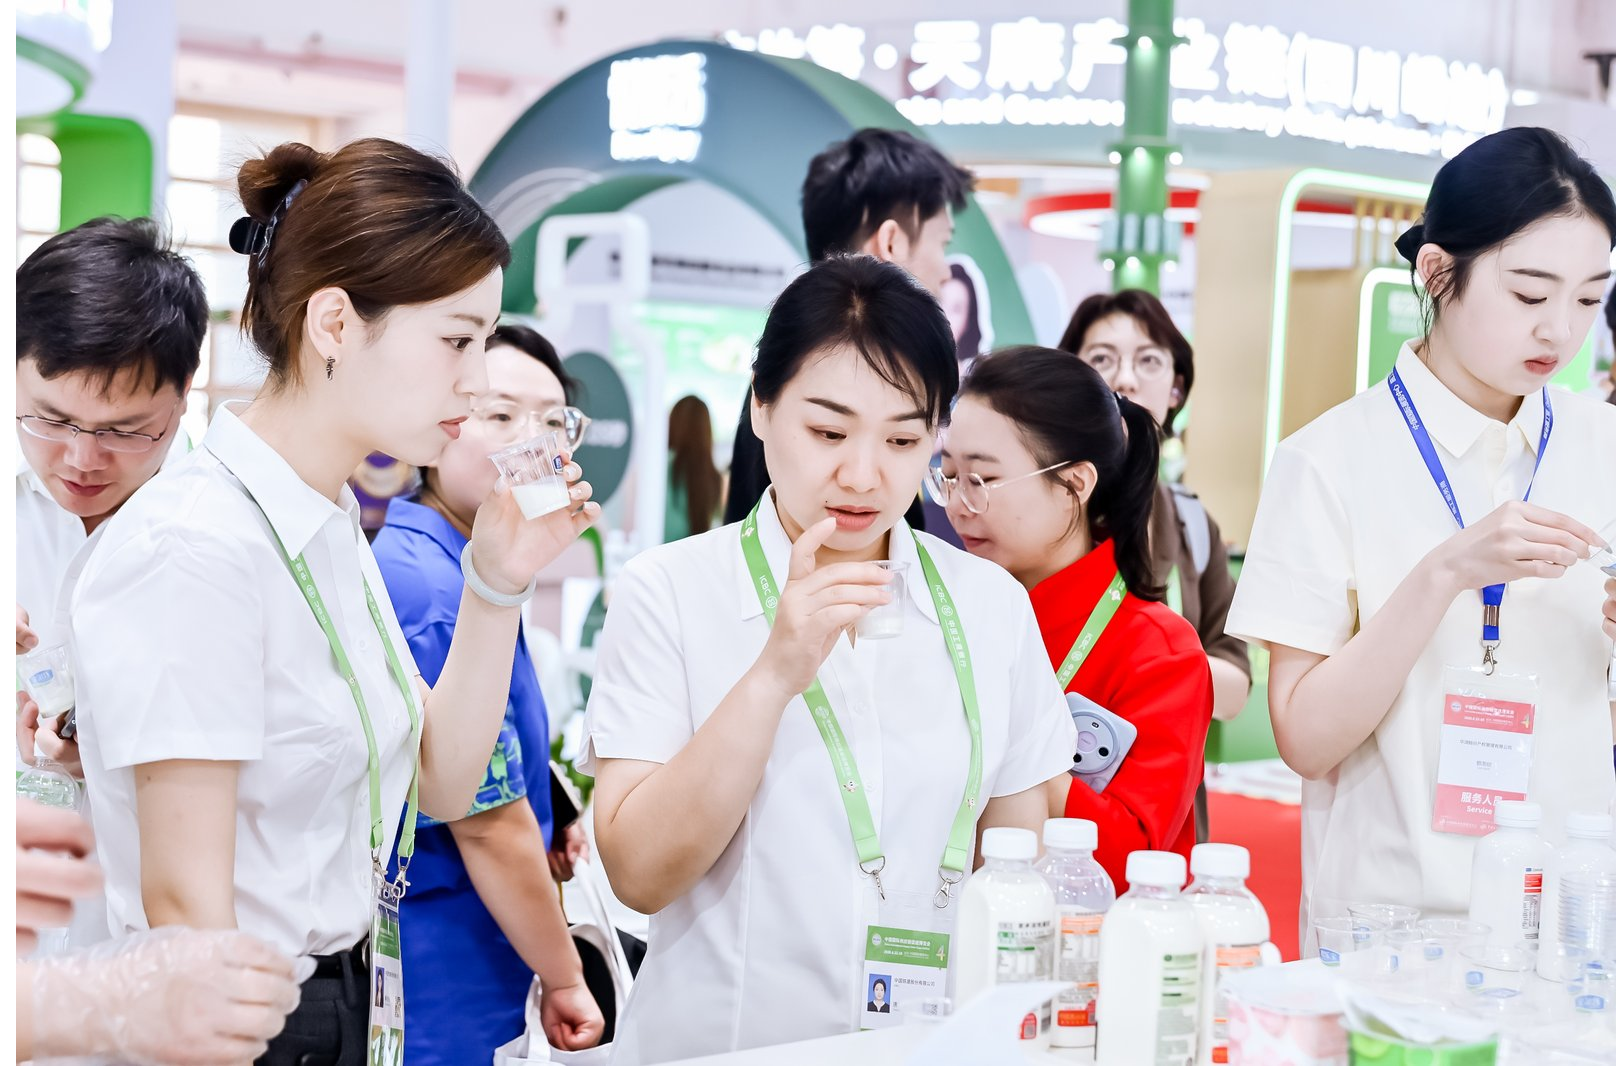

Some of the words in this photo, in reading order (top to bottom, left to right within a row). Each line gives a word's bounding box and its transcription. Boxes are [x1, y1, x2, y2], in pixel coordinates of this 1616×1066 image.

[758, 574, 772, 596] ICBC
[935, 584, 947, 604] ICBC
[1466, 805, 1493, 815] Service
